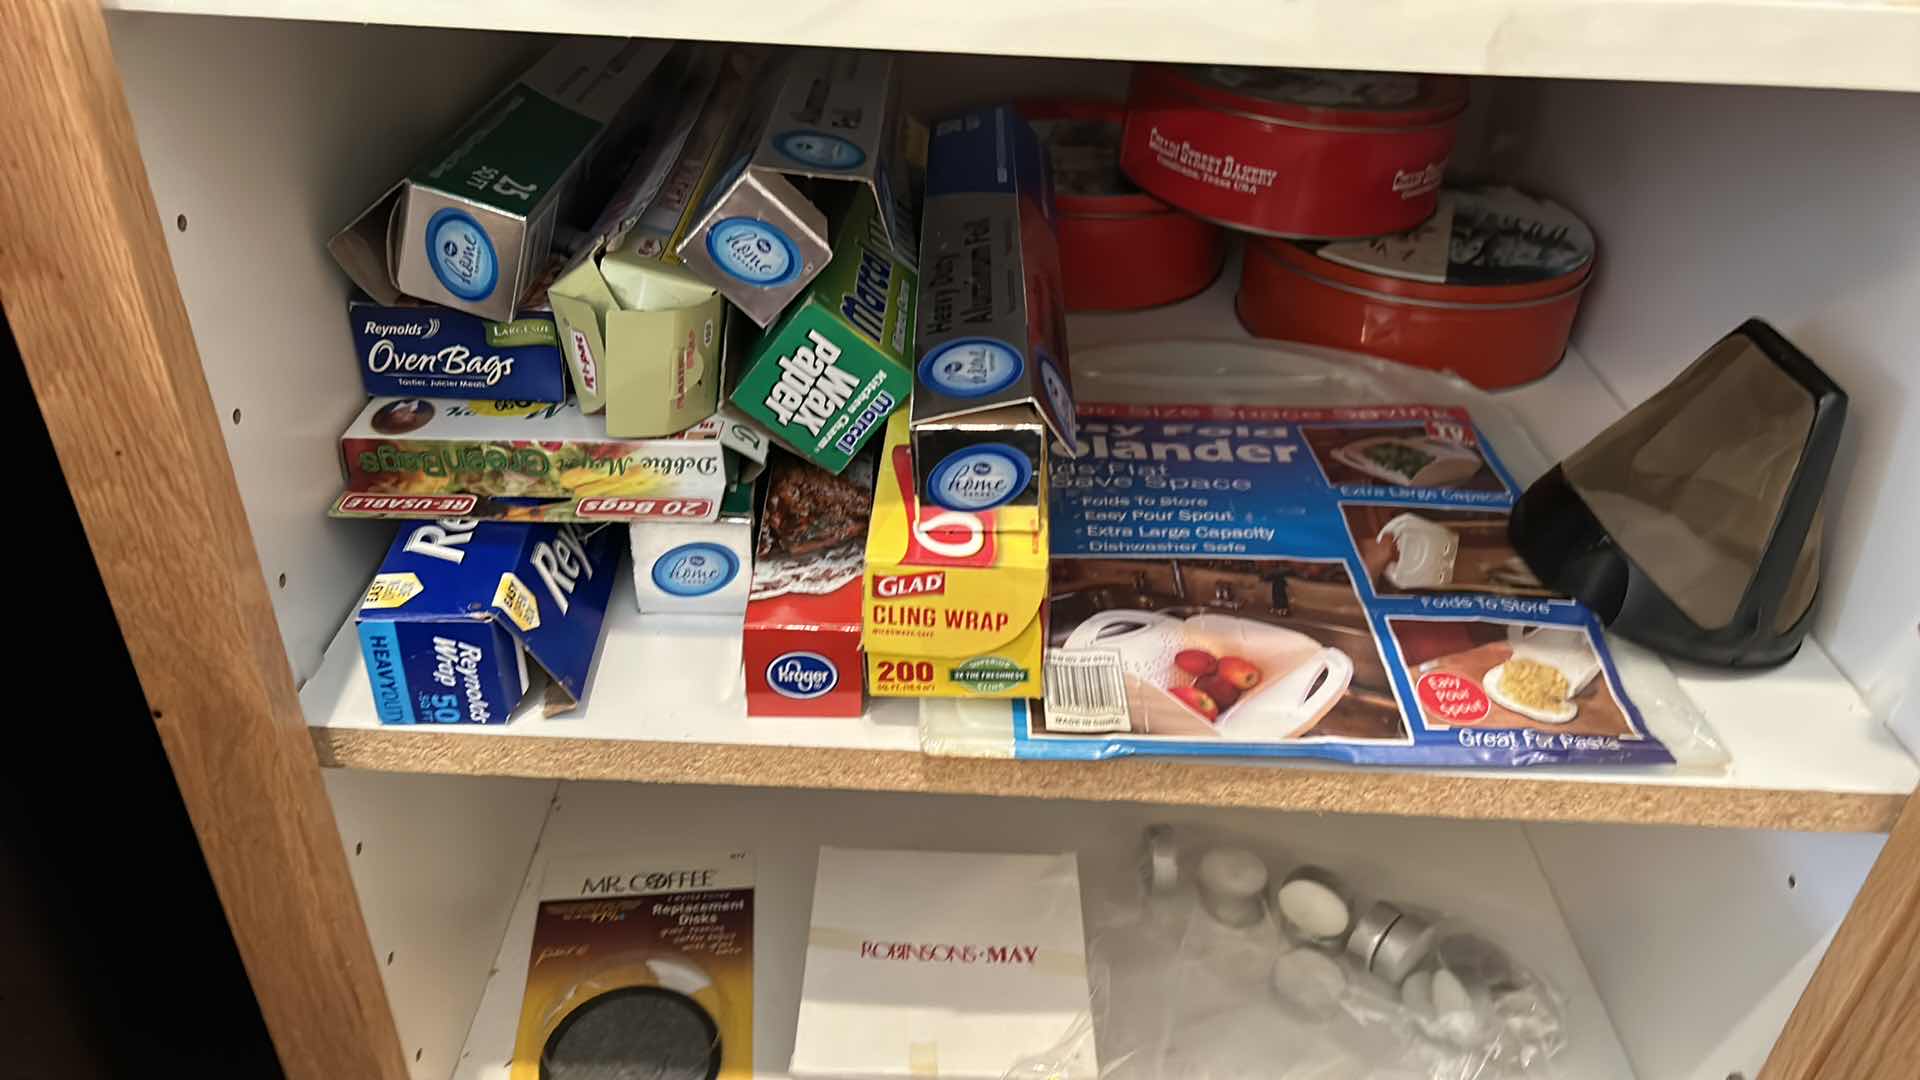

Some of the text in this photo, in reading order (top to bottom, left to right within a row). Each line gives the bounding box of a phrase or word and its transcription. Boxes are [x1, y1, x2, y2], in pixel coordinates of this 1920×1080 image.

[364, 319, 423, 338] Reynolds
[368, 339, 515, 386] Oven Bags
[765, 328, 844, 428] Paper
[795, 366, 862, 438] Wax
[1051, 434, 1299, 464] olander
[640, 455, 719, 478] Debbie
[948, 463, 1008, 491] home
[344, 496, 471, 513] RE-USABLE
[584, 499, 704, 517] 20 Bags
[1132, 510, 1175, 522] Pour
[1178, 509, 1233, 524] Spout
[1087, 525, 1133, 537] Extra
[877, 573, 944, 597] GLAD
[872, 604, 1010, 634] CLING WRAP
[432, 635, 460, 687] Wrap
[877, 661, 934, 683] 200
[455, 641, 491, 725] Reynolds
[778, 659, 829, 692] Kroger
[431, 692, 461, 724] 50
[1458, 728, 1519, 749] Great
[628, 868, 718, 891] COFFEE
[652, 899, 745, 916] Replacement
[679, 913, 719, 926] Disks
